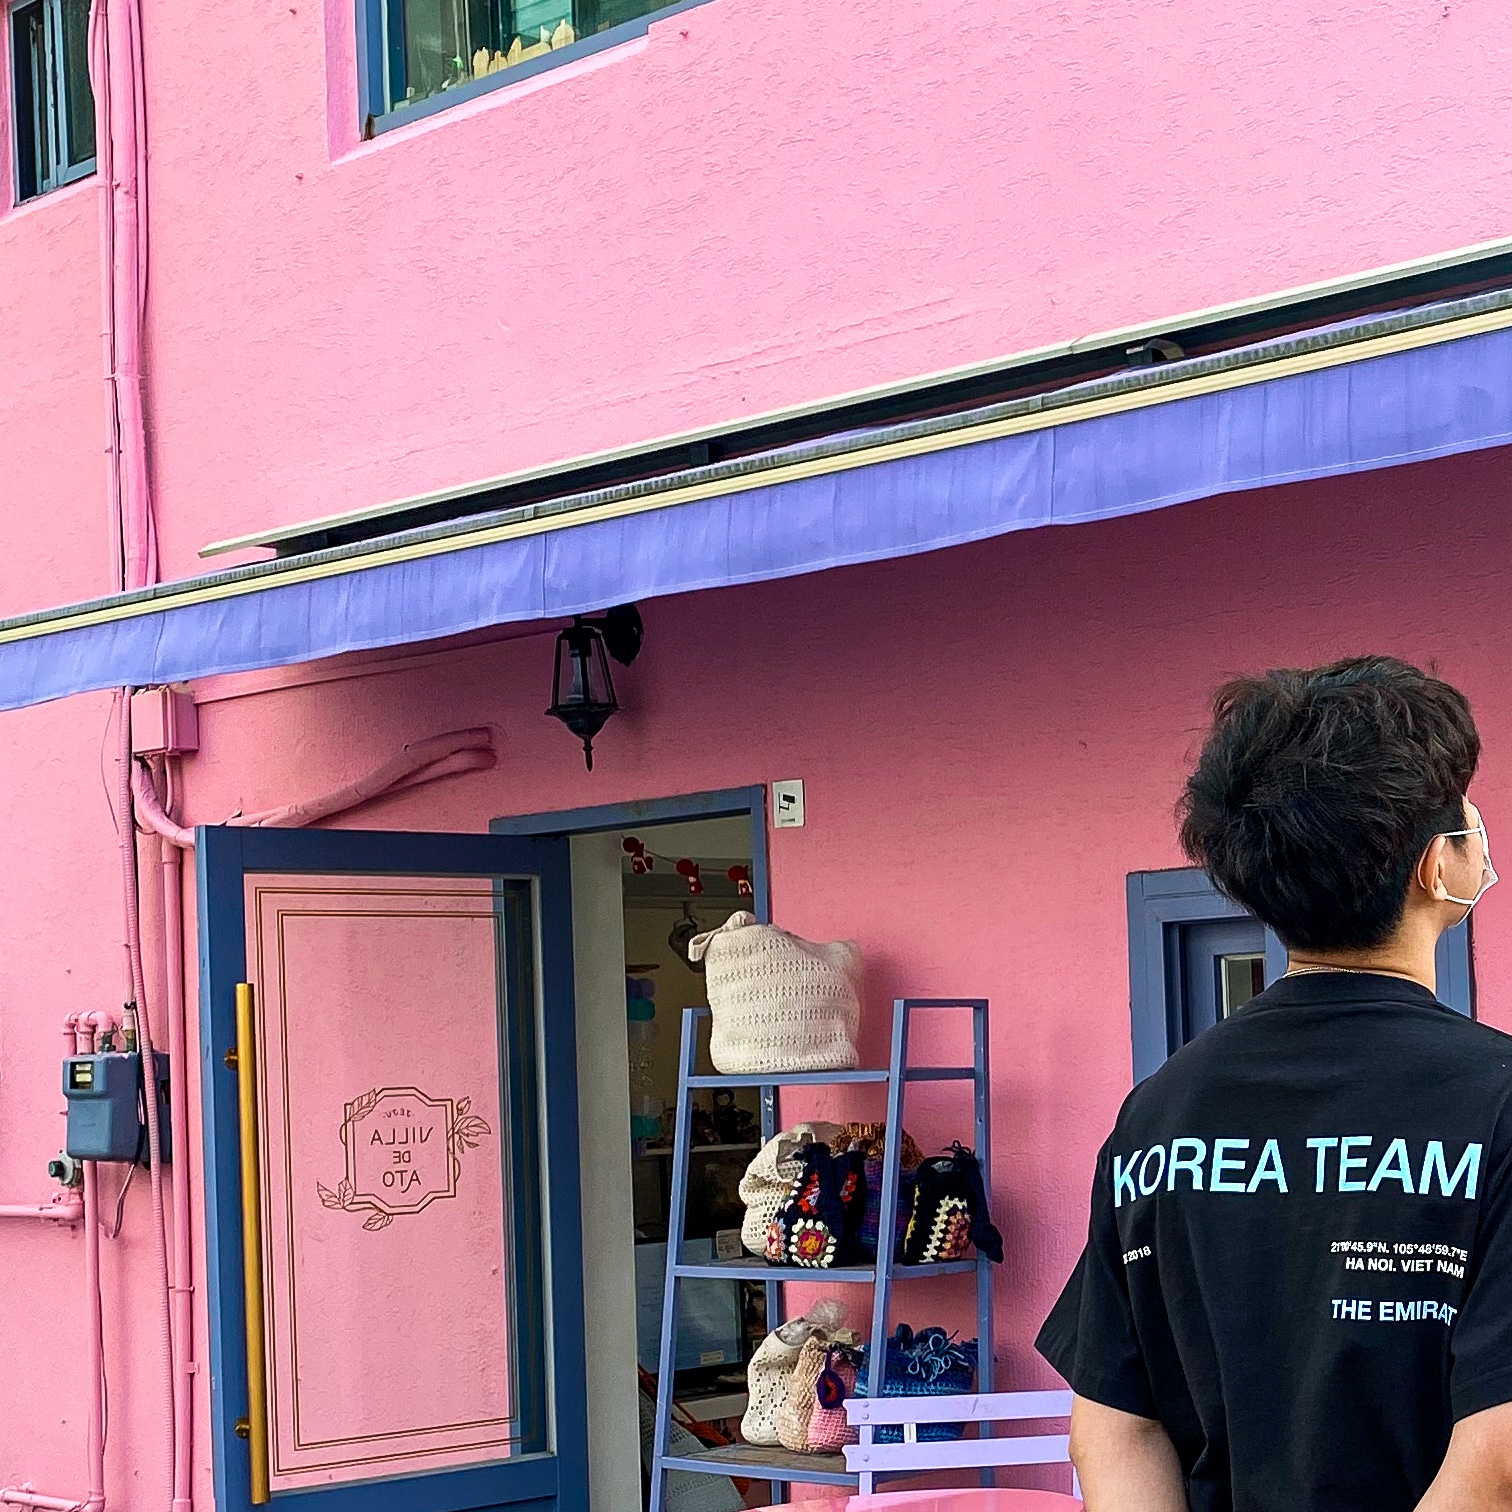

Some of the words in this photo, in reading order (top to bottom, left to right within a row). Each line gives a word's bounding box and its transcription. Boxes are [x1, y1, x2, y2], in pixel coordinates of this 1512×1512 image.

[1113, 1137, 1289, 1207] KOREA
[1306, 1135, 1482, 1199] TEAM
[1345, 1256, 1365, 1271] HA
[1367, 1257, 1397, 1272] NOI.
[1400, 1258, 1434, 1272] VIET
[1436, 1259, 1465, 1279] NAM
[1331, 1299, 1373, 1321] THE
